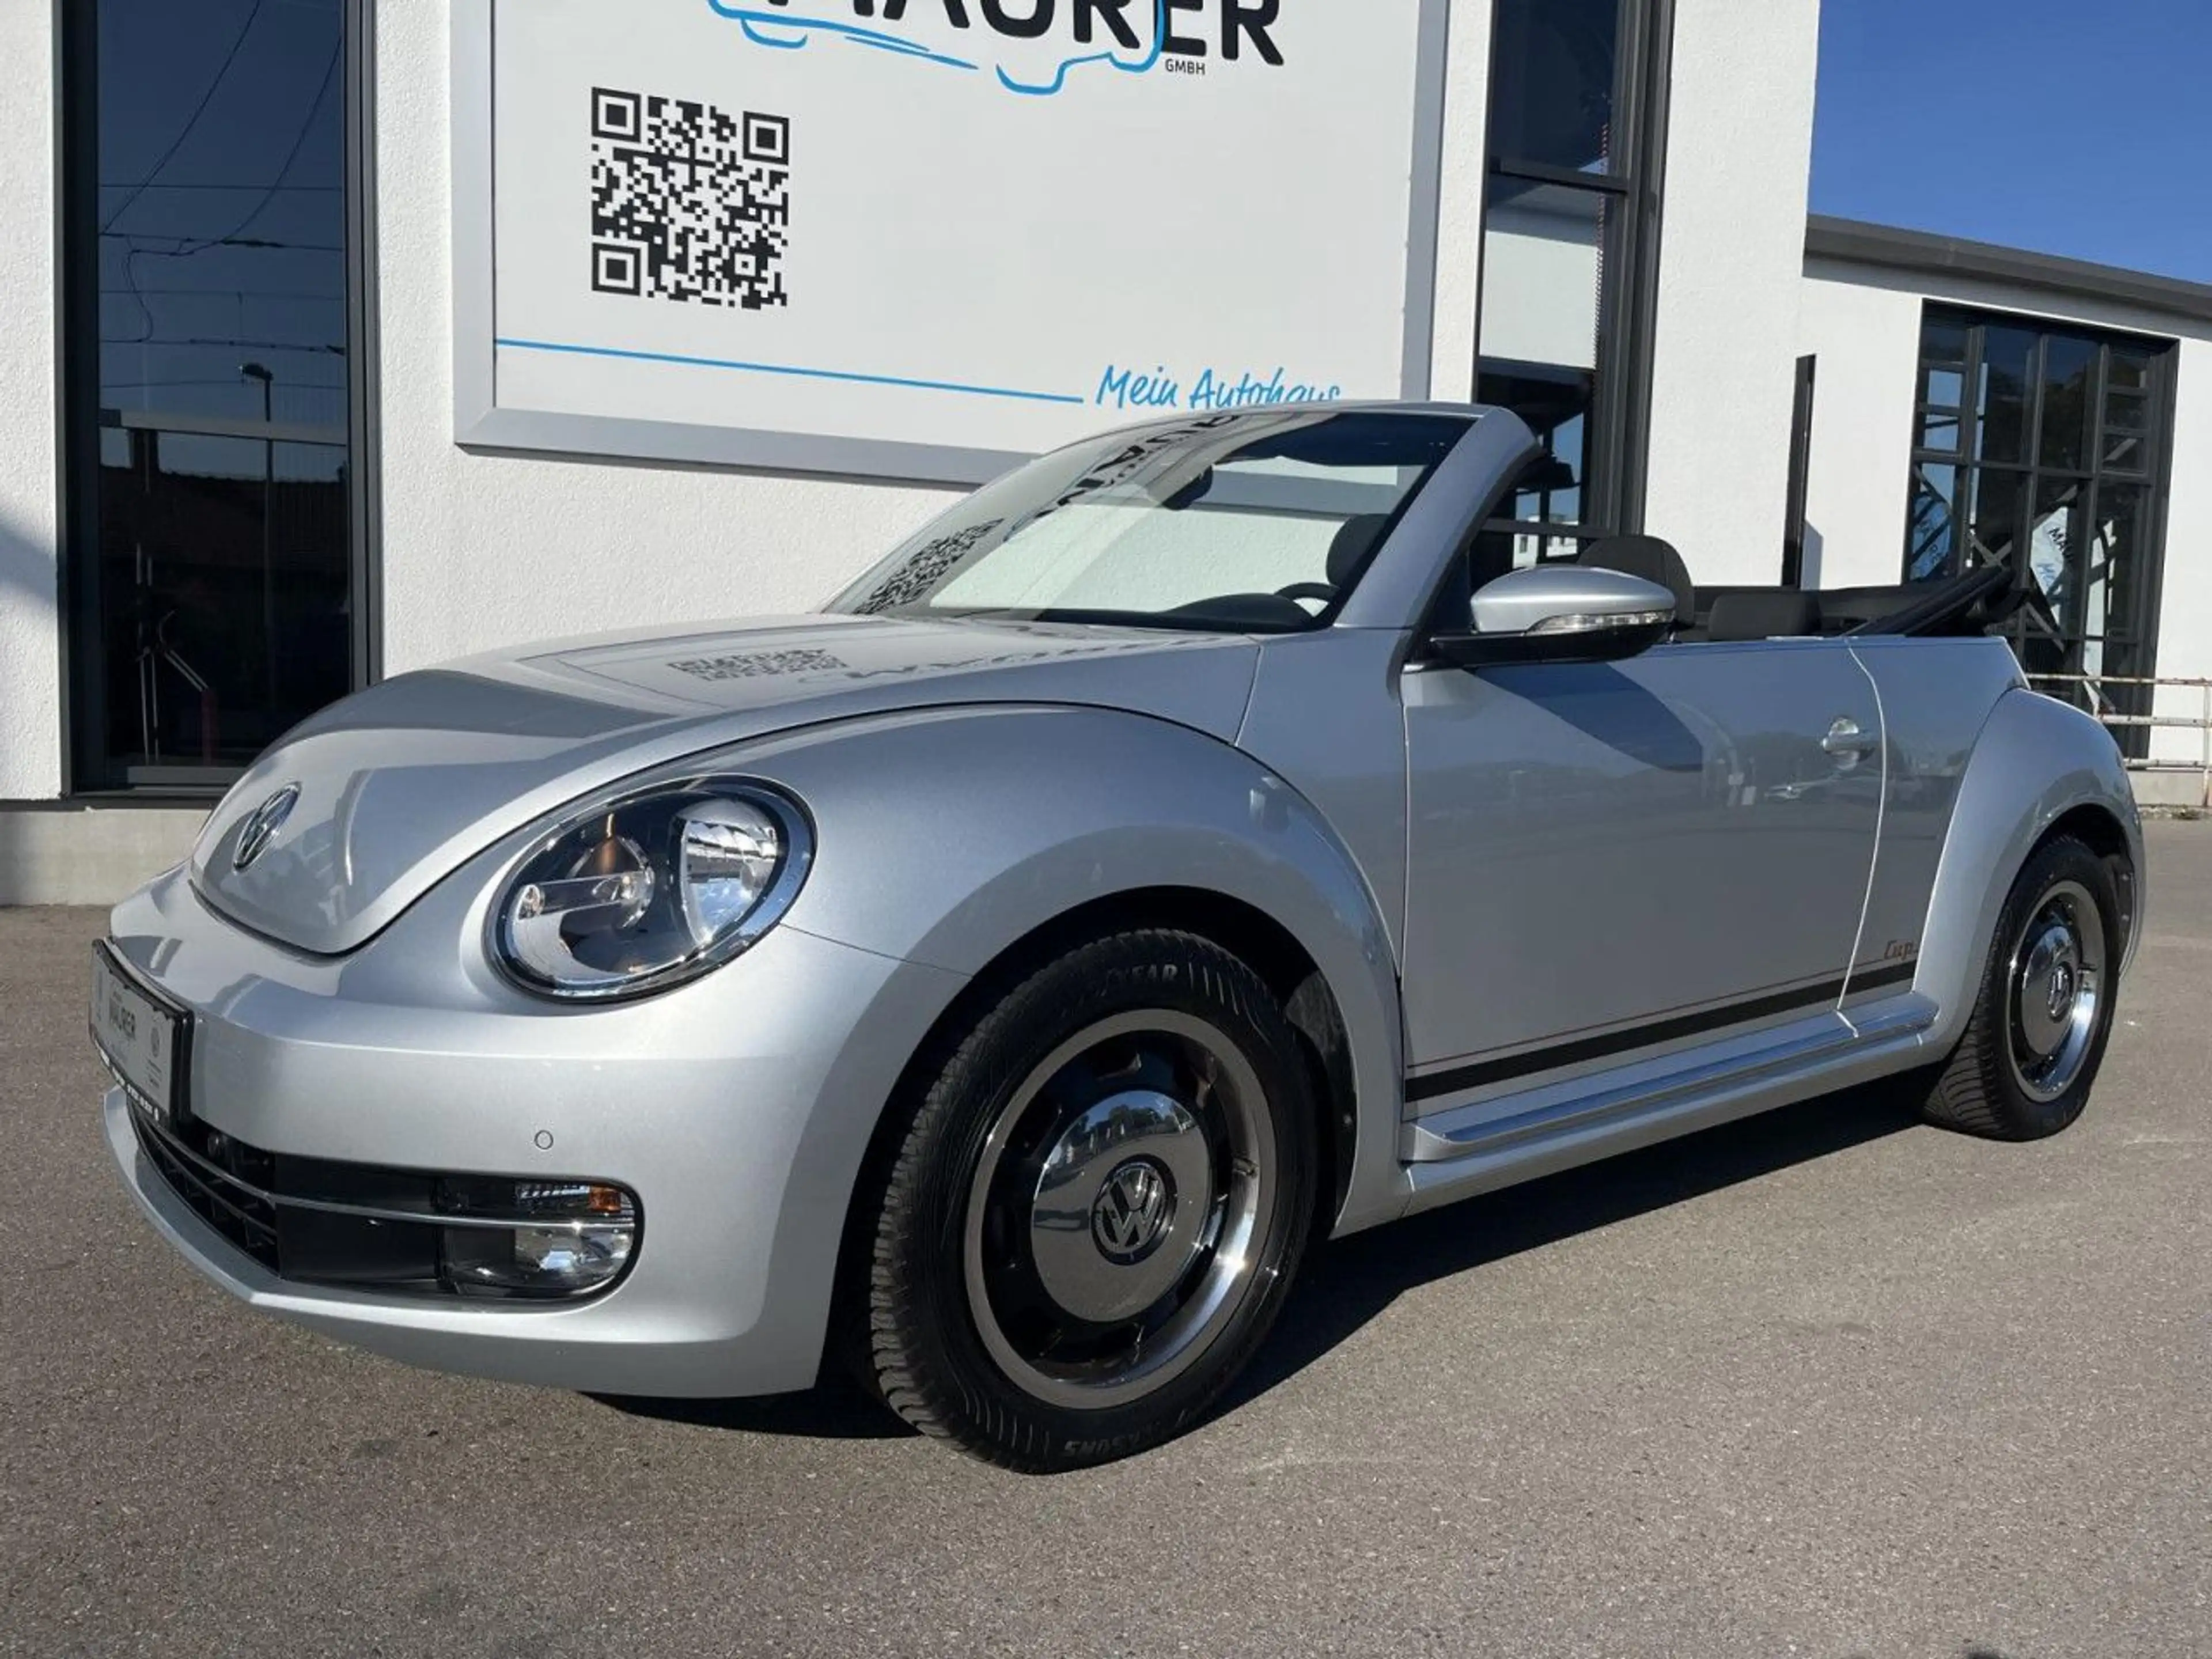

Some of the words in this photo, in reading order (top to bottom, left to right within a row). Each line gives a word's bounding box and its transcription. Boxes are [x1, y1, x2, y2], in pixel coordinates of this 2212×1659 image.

[769, 0, 1285, 66] RER
[1165, 59, 1205, 75] GMBH
[1096, 365, 1179, 408] Mein
